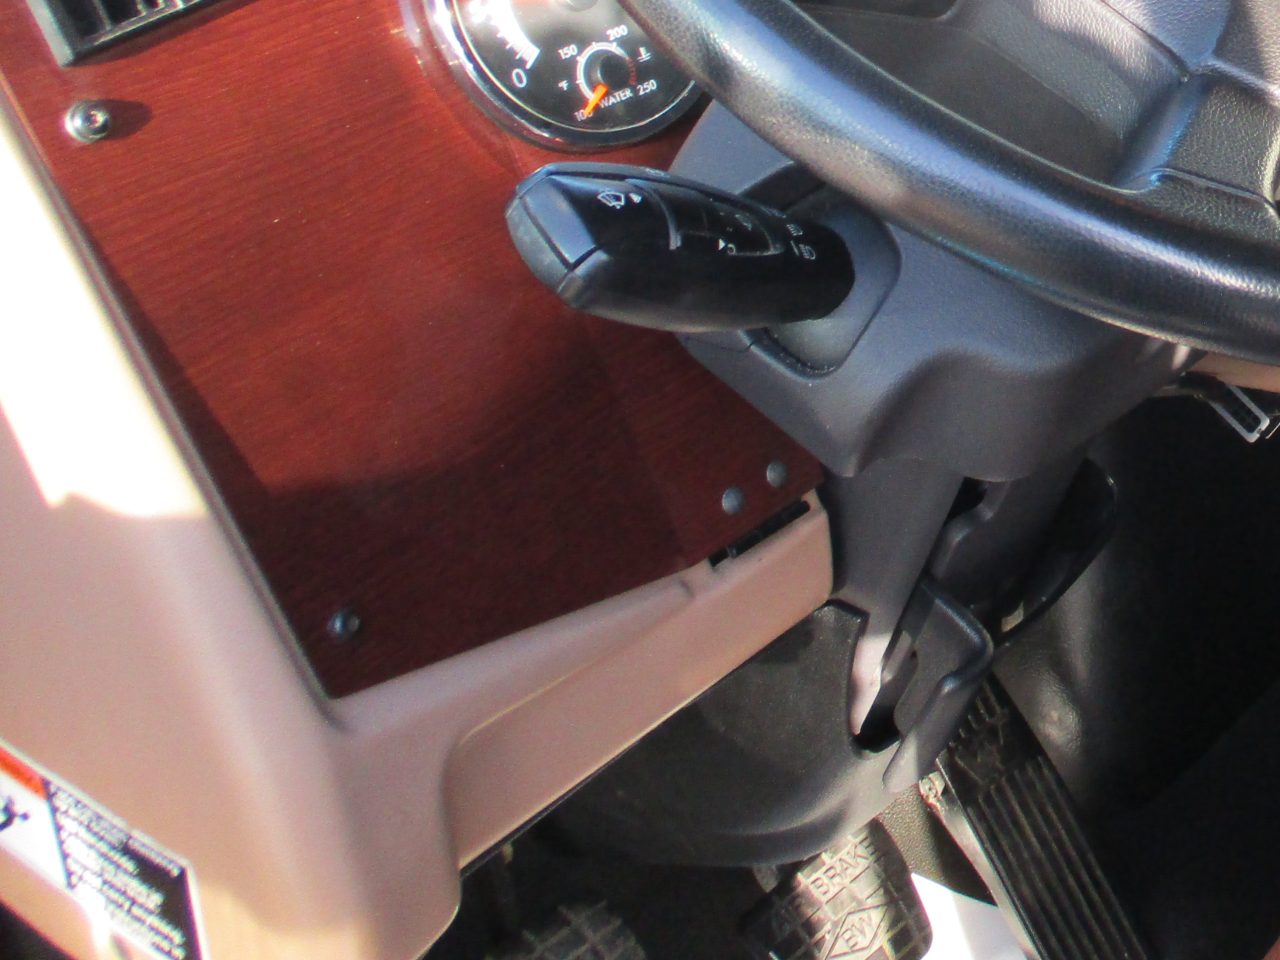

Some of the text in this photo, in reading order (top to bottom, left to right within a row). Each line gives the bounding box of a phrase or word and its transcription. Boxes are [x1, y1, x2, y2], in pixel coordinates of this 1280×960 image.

[606, 24, 629, 42] 200
[557, 43, 578, 61] 150
[510, 68, 528, 89] 0
[637, 78, 657, 97] 250
[598, 88, 633, 109] WATER
[810, 838, 879, 897] BRAKE
